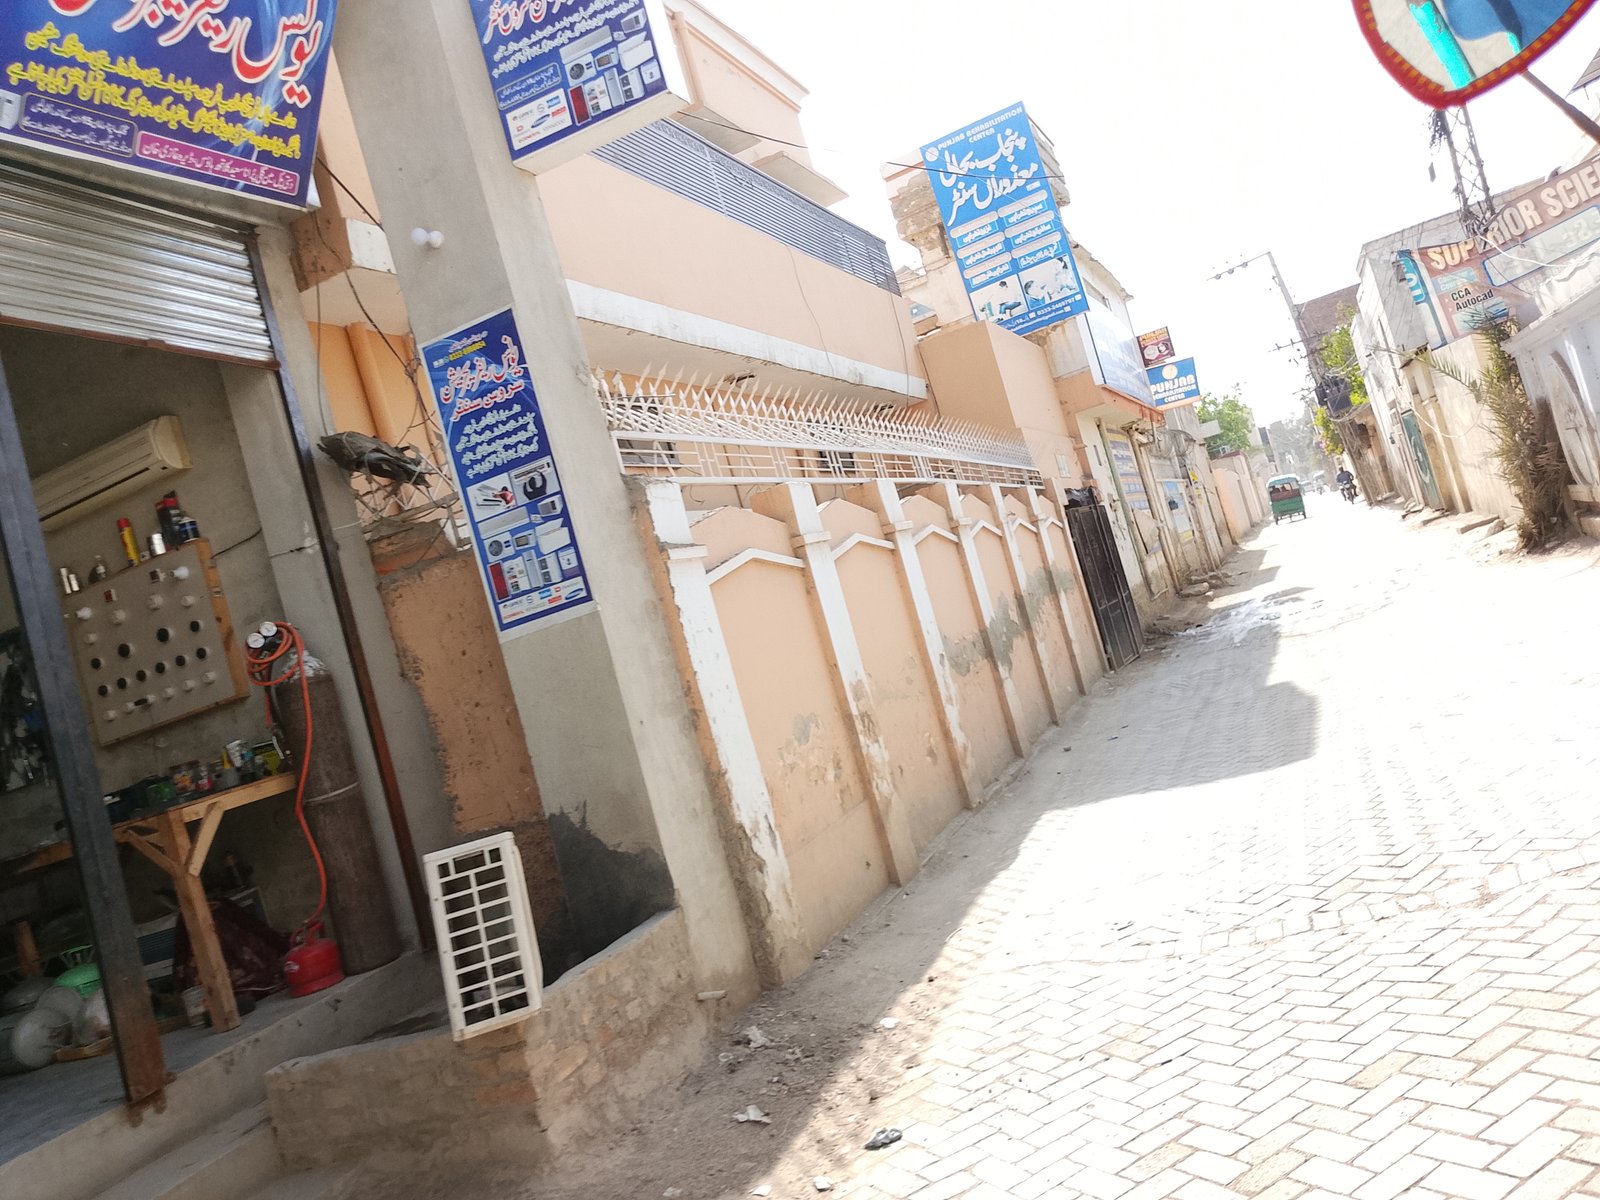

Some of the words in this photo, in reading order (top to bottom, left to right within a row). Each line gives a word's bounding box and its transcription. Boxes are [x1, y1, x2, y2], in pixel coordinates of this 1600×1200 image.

[938, 133, 965, 150] PUNJAB
[966, 106, 1022, 137] REHABILITATION
[968, 127, 995, 143] CENTER
[1427, 198, 1543, 270] SUPRIOR
[1451, 287, 1472, 302] CCA
[1455, 289, 1494, 311] Autocad
[1150, 374, 1195, 395] PUNJAB
